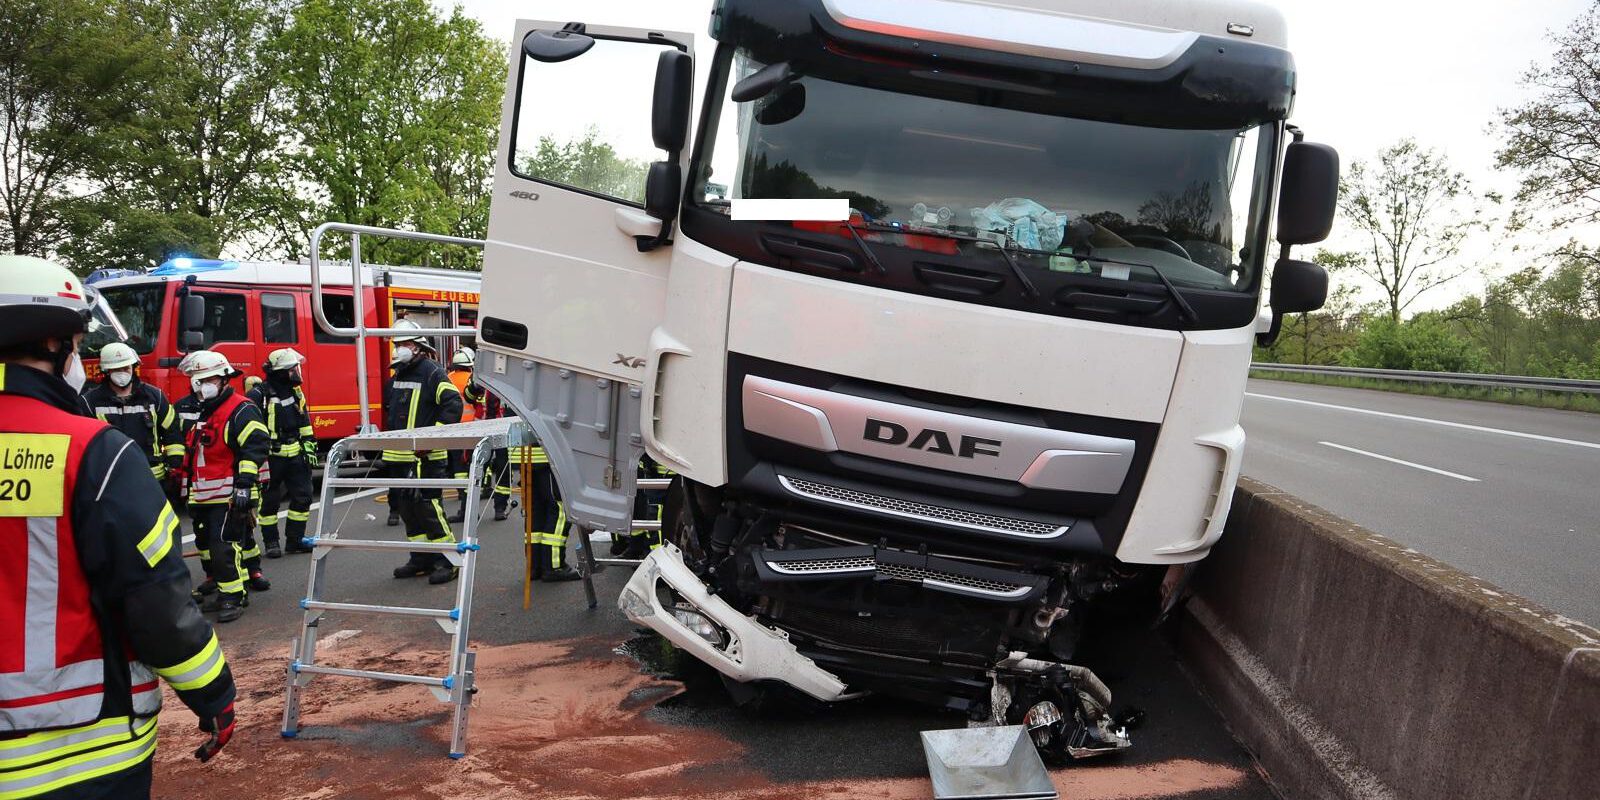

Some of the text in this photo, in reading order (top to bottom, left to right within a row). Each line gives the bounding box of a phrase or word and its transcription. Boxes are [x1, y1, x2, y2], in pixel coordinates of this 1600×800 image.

[509, 190, 540, 201] 480
[612, 353, 646, 369] XF
[863, 418, 1002, 458] DAF
[4, 448, 54, 470] Löhne
